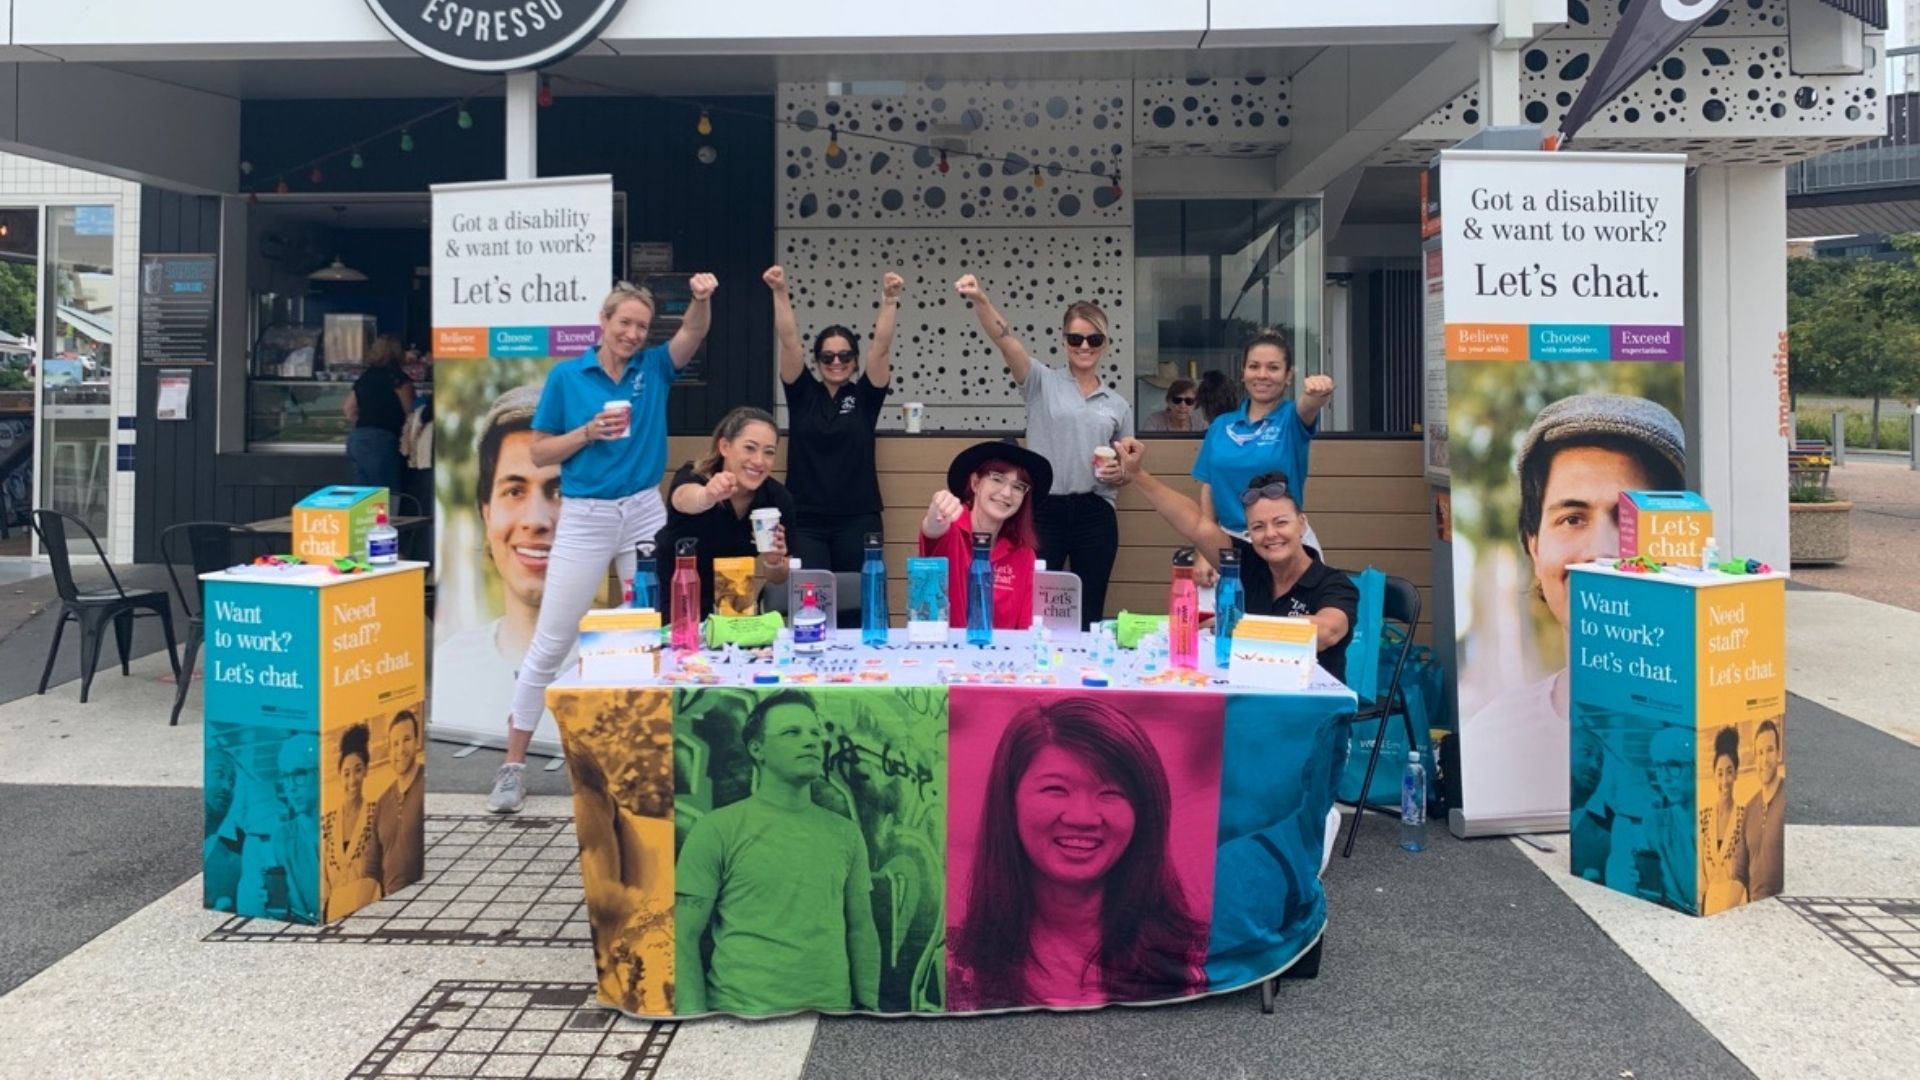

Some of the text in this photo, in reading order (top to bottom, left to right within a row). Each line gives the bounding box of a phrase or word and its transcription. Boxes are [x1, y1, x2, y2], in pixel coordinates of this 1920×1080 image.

[421, 0, 563, 41] ESPRESSO
[1471, 188, 1659, 219] Got a disability
[452, 209, 590, 233] Got a disability
[1463, 217, 1667, 242] & want to work?
[445, 233, 596, 258] & want to work?
[452, 273, 587, 305] Let's chat.
[1474, 263, 1557, 297] Let's
[1572, 263, 1659, 298] chat.
[497, 332, 533, 344] Choose
[556, 331, 595, 343] Exceed
[1459, 330, 1509, 343] Believe
[1540, 330, 1590, 343] Choose
[1622, 331, 1671, 345] Exceed
[1773, 331, 1789, 437] amenities
[302, 513, 340, 535] Let's
[1651, 515, 1700, 536] Let's
[301, 534, 341, 557] chat.
[1648, 536, 1702, 558] chat.
[1039, 591, 1073, 605] "Let's
[1579, 590, 1632, 618] Want
[214, 600, 262, 624] Want
[333, 598, 376, 625] Need
[1708, 602, 1746, 628] Need
[214, 629, 292, 652] to work?
[332, 623, 381, 652] staff?
[1580, 618, 1665, 648] to work?
[1708, 628, 1750, 654] staff?
[214, 660, 304, 689] Let's chat.
[333, 652, 415, 688] Let's chat.
[1580, 647, 1678, 684] Let's chat.
[1708, 659, 1776, 688] Let's chat.
